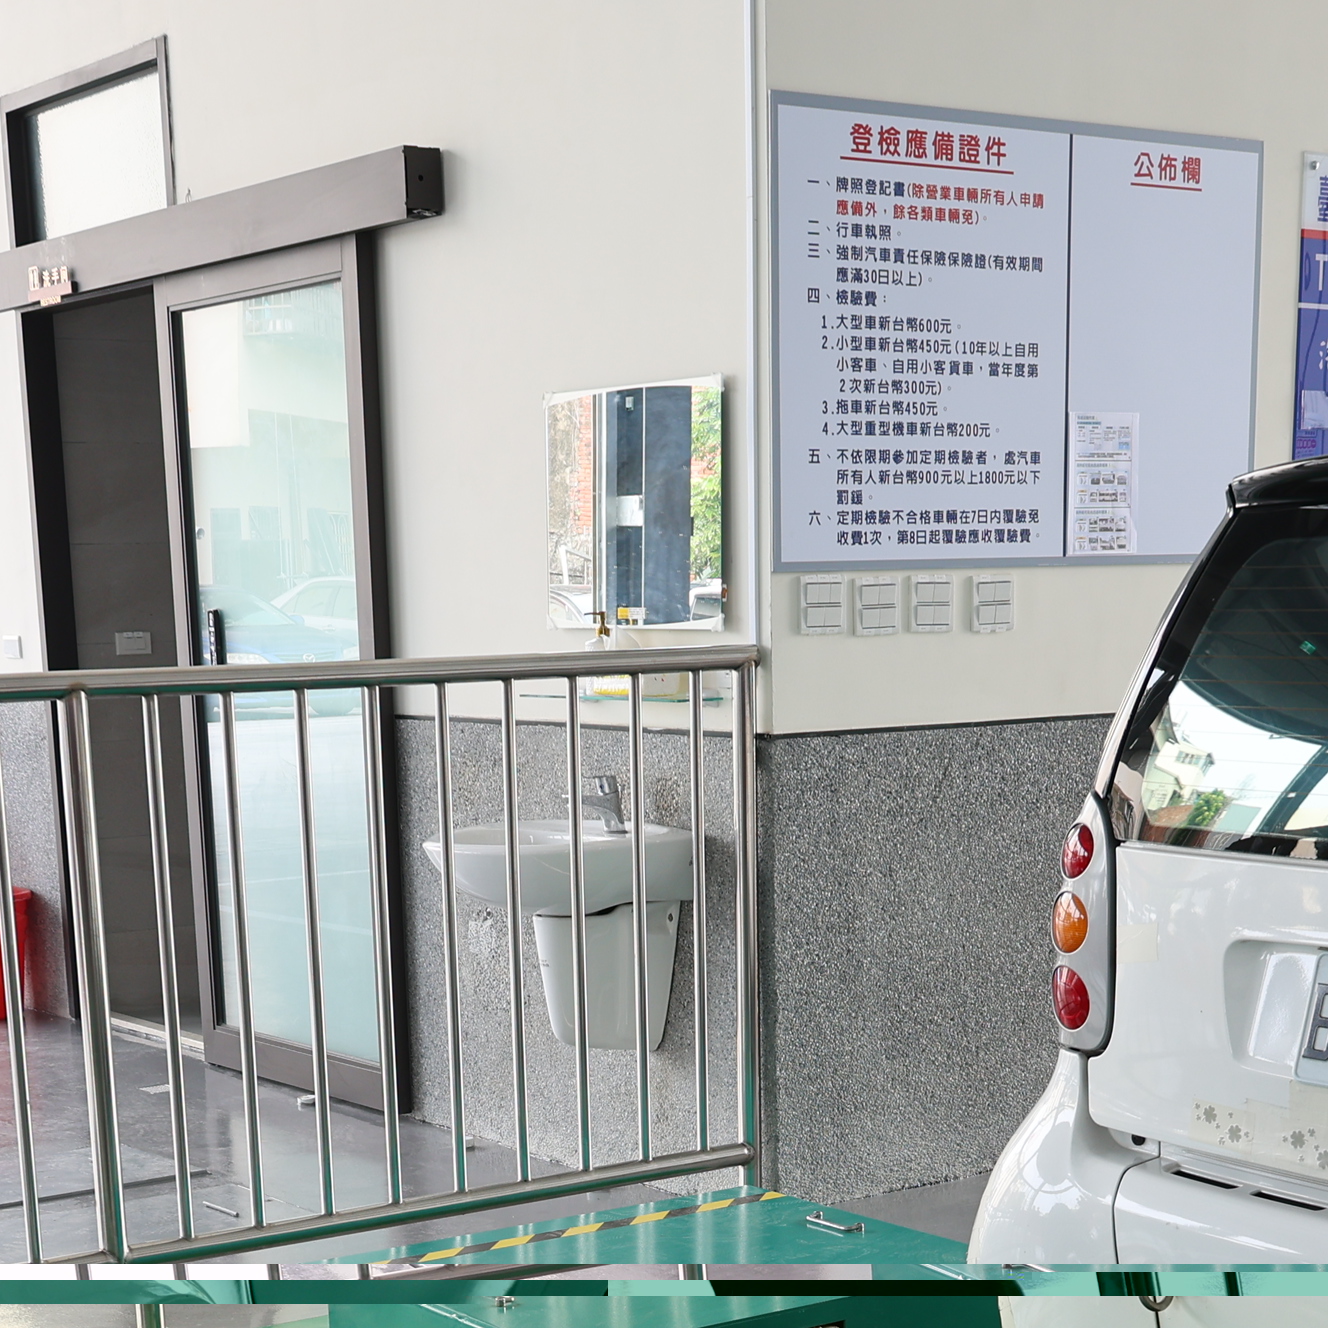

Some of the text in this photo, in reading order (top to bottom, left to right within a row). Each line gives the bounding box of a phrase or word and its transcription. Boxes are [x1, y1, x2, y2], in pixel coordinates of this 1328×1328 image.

[849, 122, 1007, 167] 登檢應備證件
[1133, 151, 1202, 185] 公佈欄
[836, 469, 1041, 486] 所有人新台幣900元以上1800元以下
